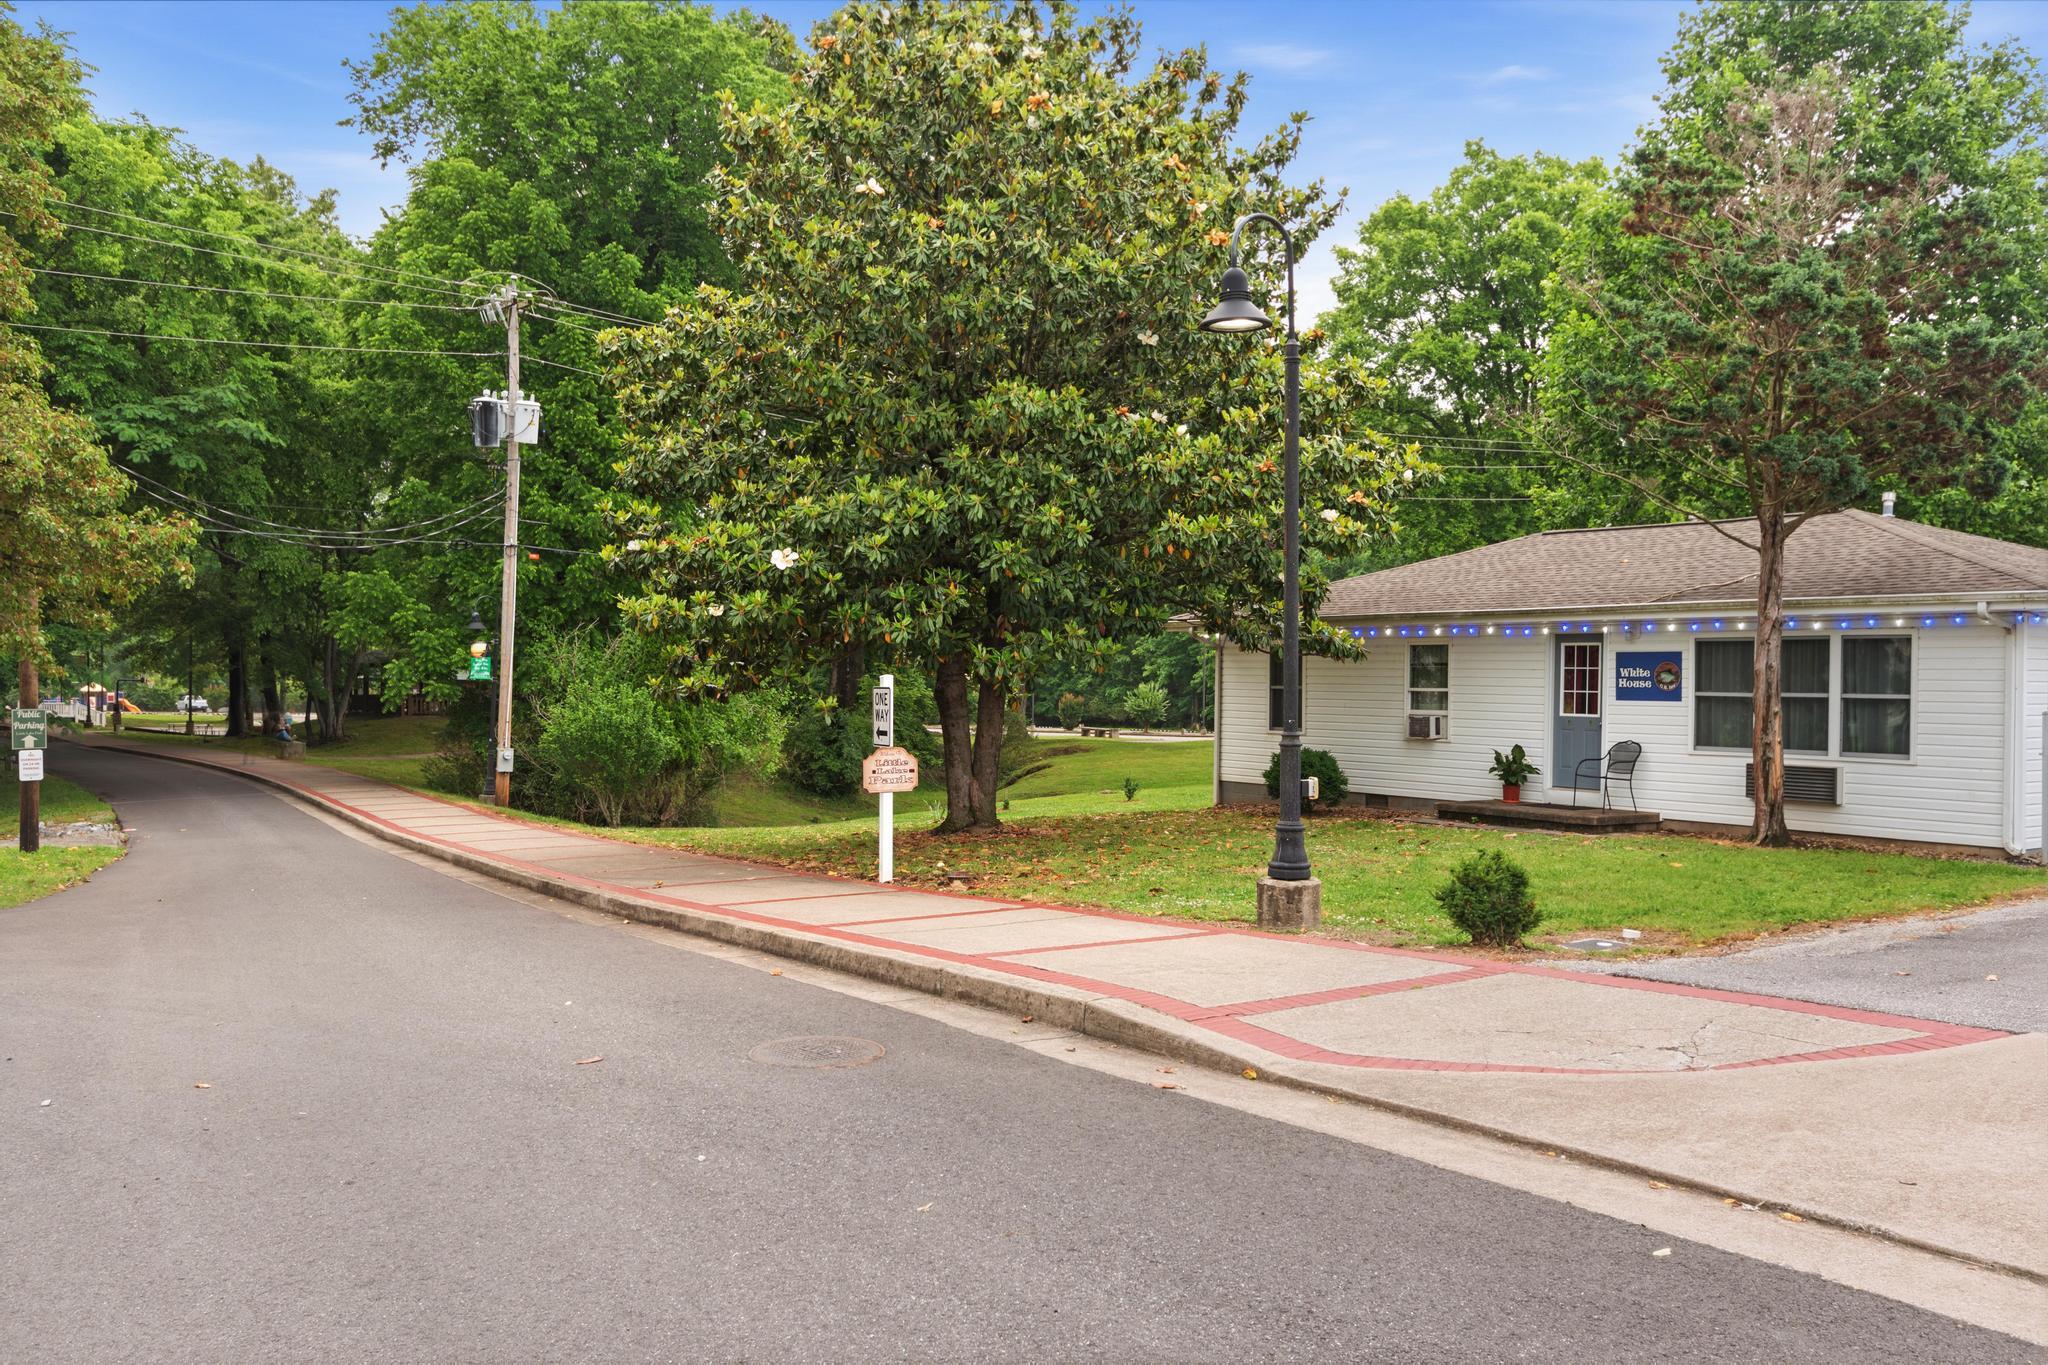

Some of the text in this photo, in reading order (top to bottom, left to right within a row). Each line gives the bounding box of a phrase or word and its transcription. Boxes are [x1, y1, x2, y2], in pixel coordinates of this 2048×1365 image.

[1620, 667, 1651, 677] White
[1618, 678, 1652, 688] House
[875, 692, 888, 706] ONE
[16, 710, 41, 718] Public
[875, 708, 889, 722] WAY
[13, 721, 45, 731] Parking
[876, 767, 908, 775] Lake
[868, 775, 914, 785] Park
